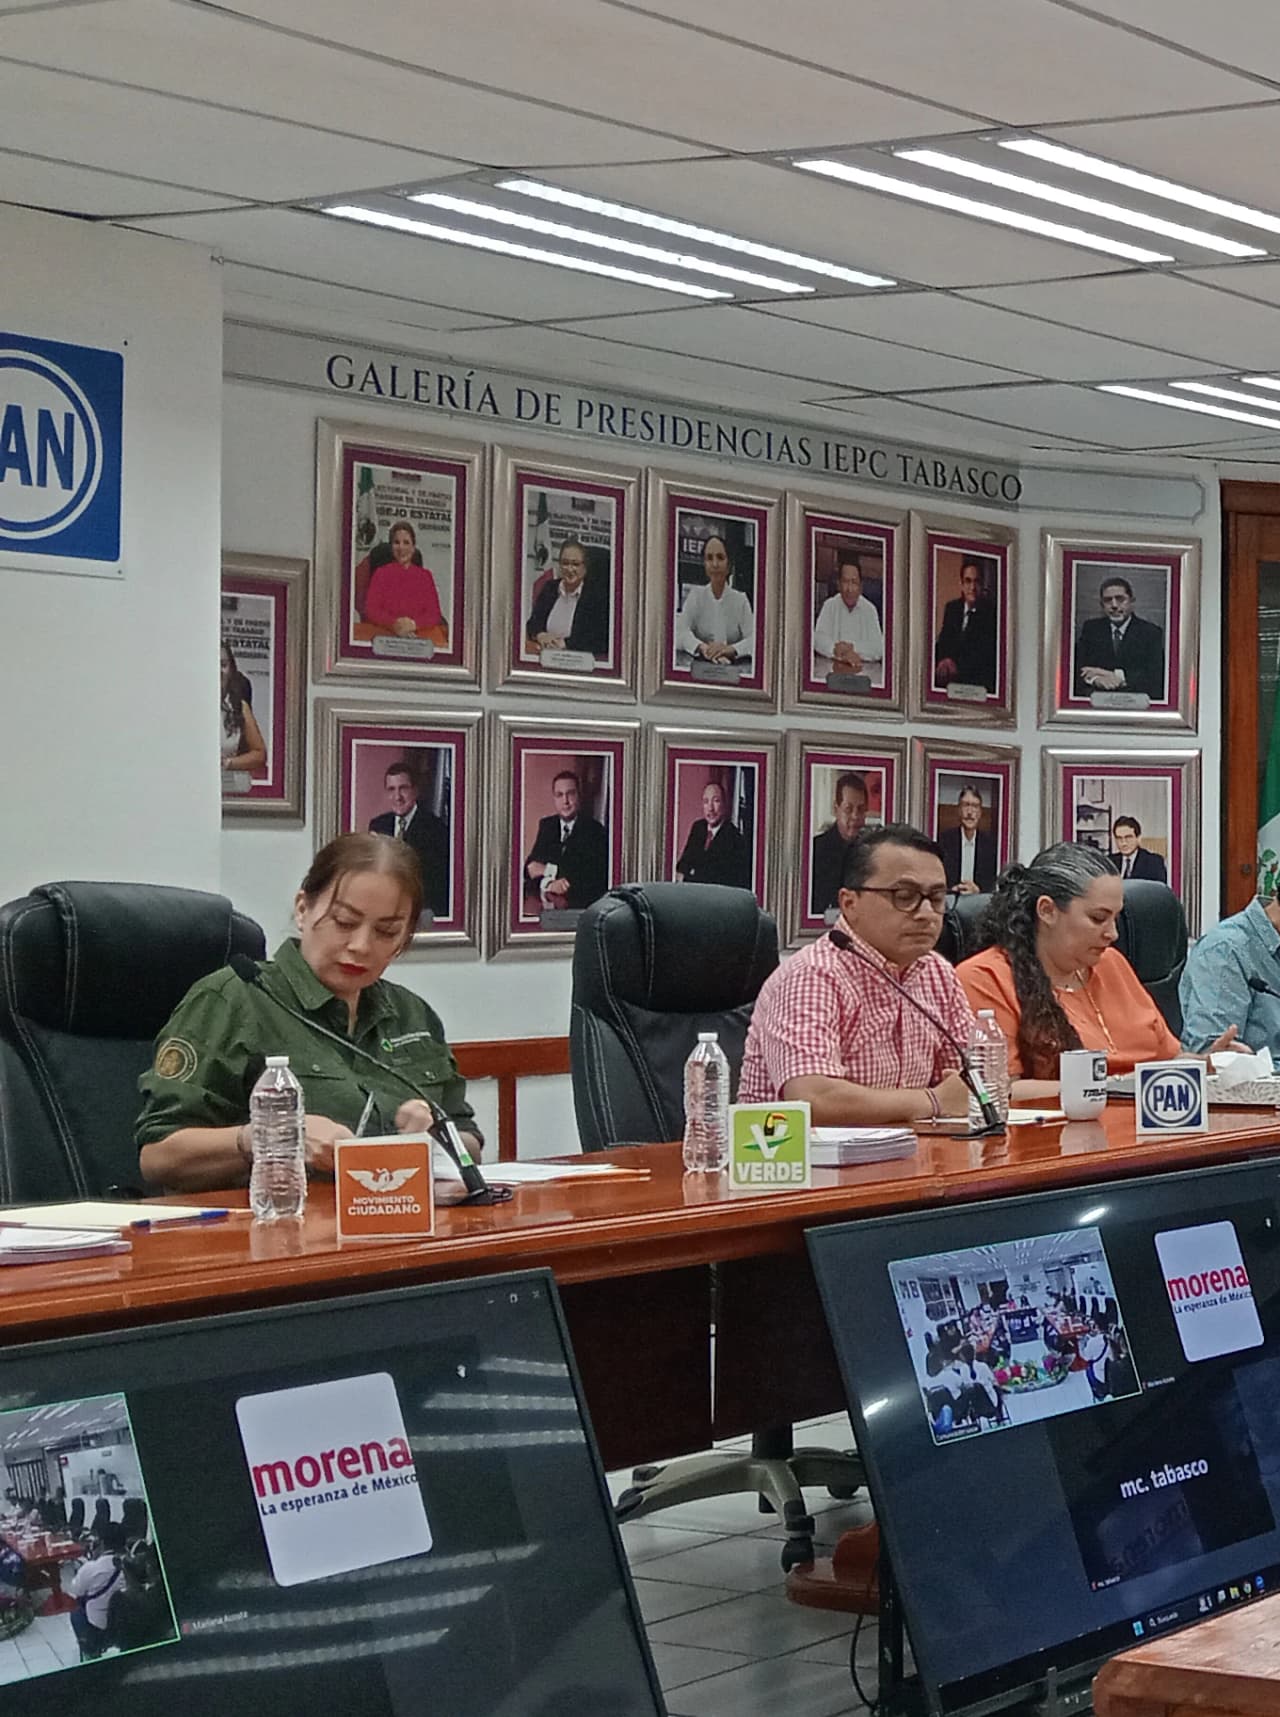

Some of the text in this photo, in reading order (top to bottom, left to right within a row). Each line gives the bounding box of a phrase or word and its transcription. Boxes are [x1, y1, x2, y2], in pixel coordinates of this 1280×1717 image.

[0, 404, 74, 490] AN
[327, 355, 1022, 501] GALERÍA DE PRESIDENCIAS IEPC TABASCO
[1153, 1085, 1189, 1112] PAN
[736, 1162, 803, 1182] VERDE
[347, 1204, 421, 1216] CIUDADANO
[353, 1195, 415, 1205] MOVIMIENTO
[1168, 1265, 1249, 1302] morena
[252, 1437, 414, 1498] morena
[1120, 1459, 1208, 1498] mc. tabasco
[261, 1472, 418, 1516] La esperanza de México
